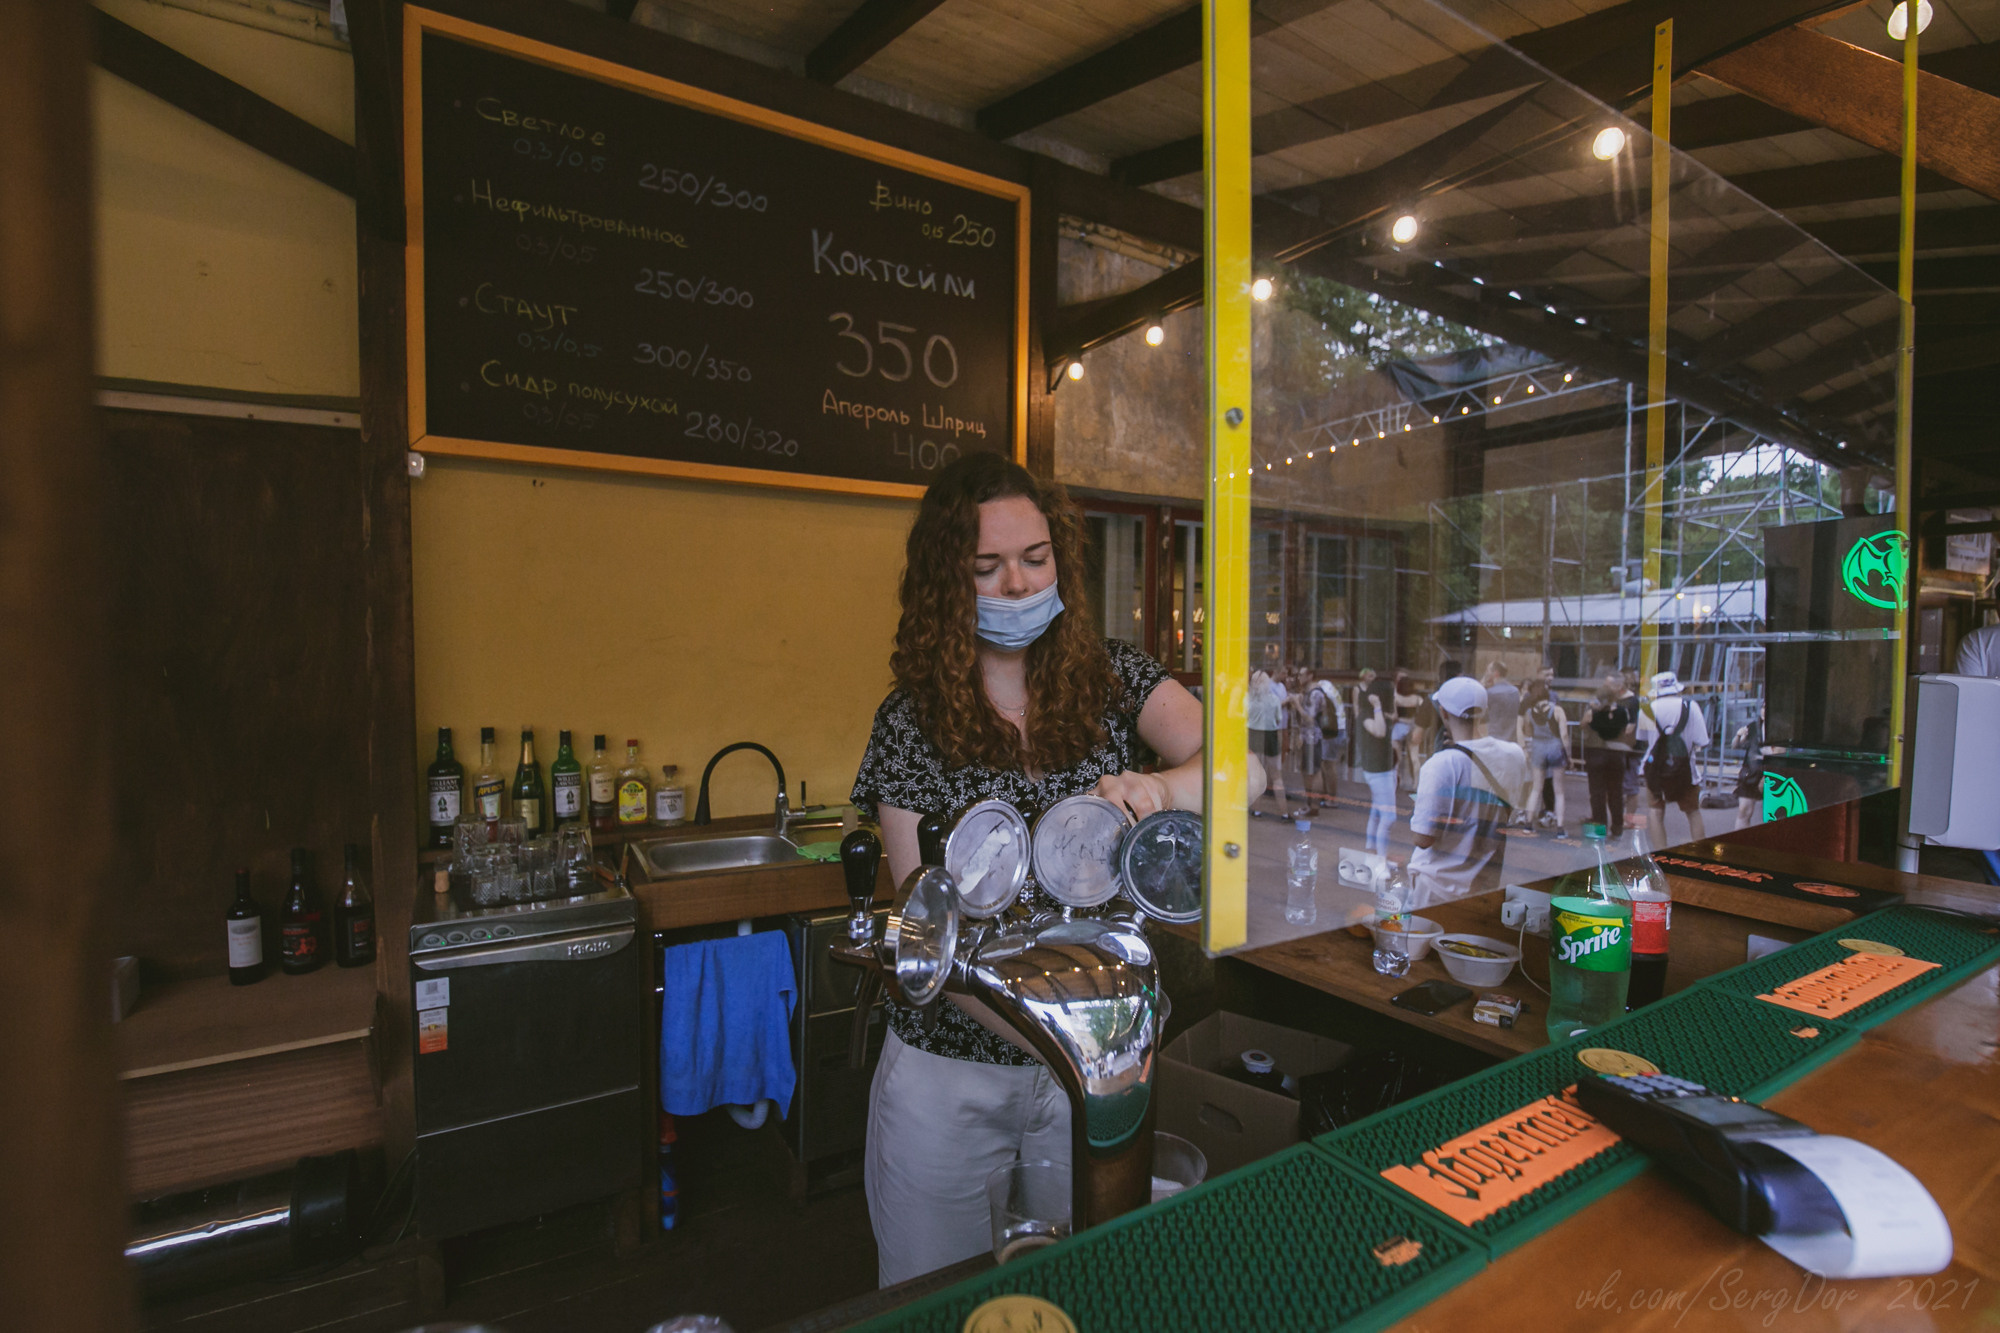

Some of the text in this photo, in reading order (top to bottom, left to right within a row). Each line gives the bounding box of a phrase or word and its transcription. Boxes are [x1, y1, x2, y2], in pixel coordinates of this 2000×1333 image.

[638, 163, 768, 213] 250/300
[869, 180, 933, 215] Вино
[947, 213, 996, 248] 250
[811, 228, 976, 300] Коктейли
[634, 267, 755, 309] 250/300
[632, 342, 753, 383] 300/350
[828, 311, 958, 389] 350
[480, 359, 679, 416] Сидр полусухой
[683, 411, 800, 458] 280/320
[822, 388, 987, 439] Апероль Шприц
[1557, 926, 1622, 964] Sprite
